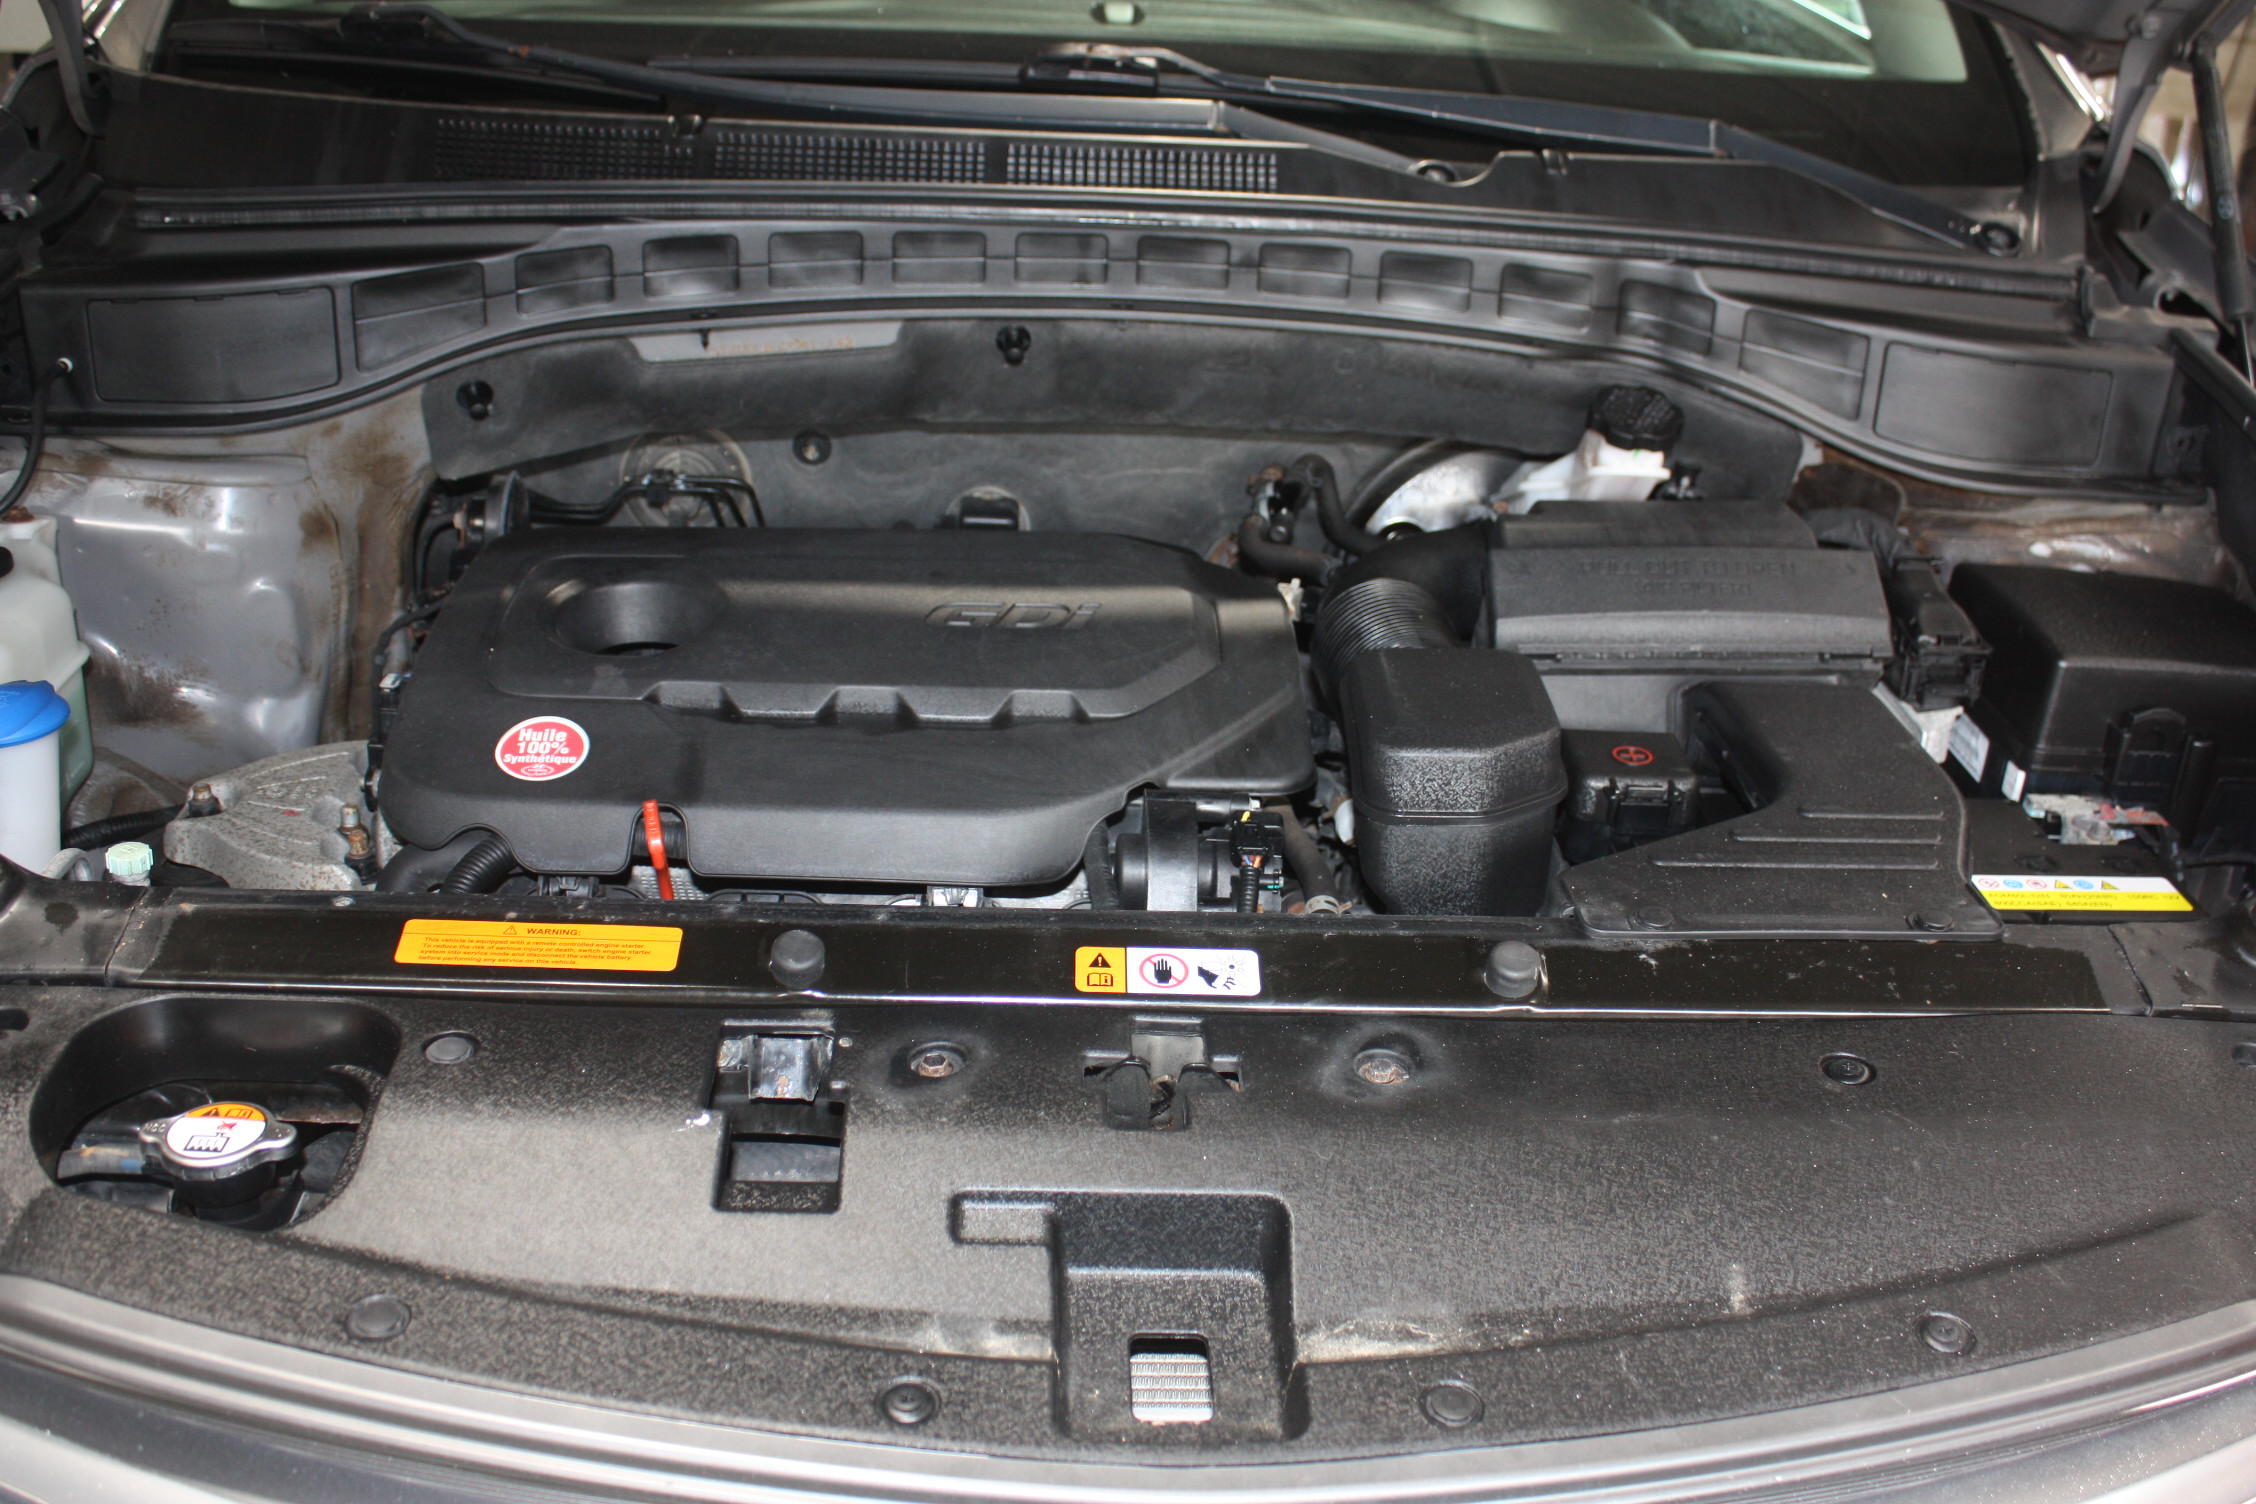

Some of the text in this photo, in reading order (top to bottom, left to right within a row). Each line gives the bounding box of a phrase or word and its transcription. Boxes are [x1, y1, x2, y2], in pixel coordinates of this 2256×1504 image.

[518, 728, 568, 741] Huile
[517, 741, 569, 754] 100%
[503, 753, 577, 765] Synthétique
[527, 928, 581, 936] WARNING:
